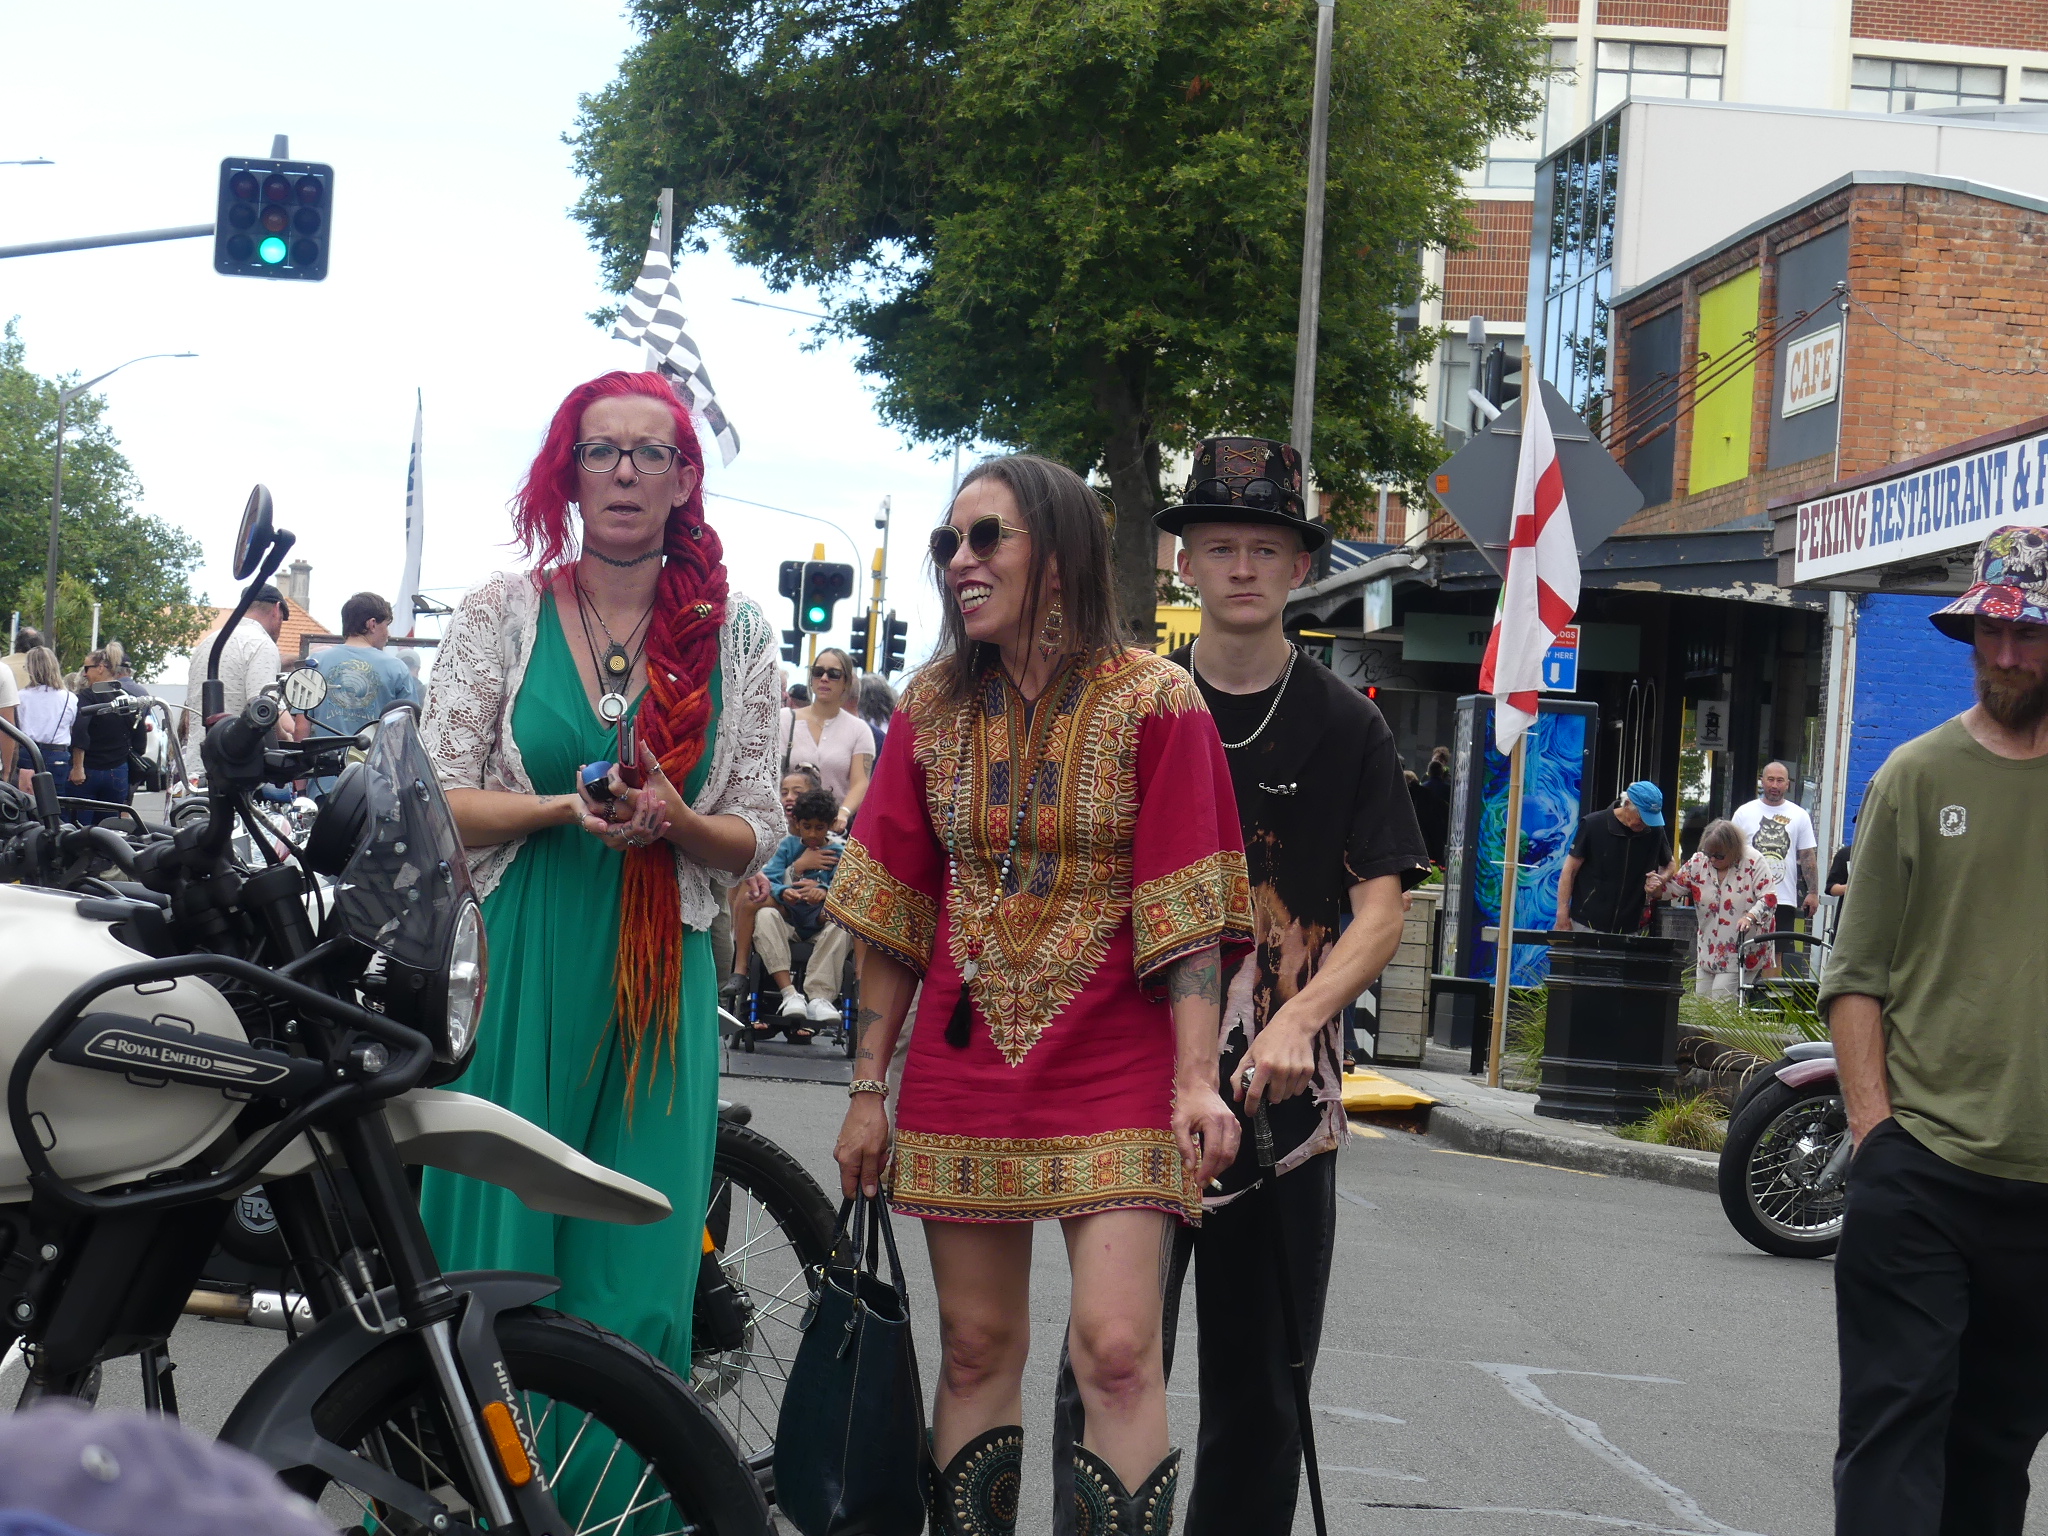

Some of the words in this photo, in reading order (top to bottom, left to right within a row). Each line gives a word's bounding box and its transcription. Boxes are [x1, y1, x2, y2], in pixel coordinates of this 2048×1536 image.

[1790, 338, 1834, 403] CAFE
[1798, 491, 1867, 563] PEKING
[1869, 450, 2008, 547] RESTAURANT
[2012, 444, 2031, 512] &
[1554, 651, 1574, 659] HERE
[118, 1039, 158, 1058] ROYAL
[161, 1048, 212, 1069] ENFIELD
[493, 1361, 549, 1492] HIMALAYAN
